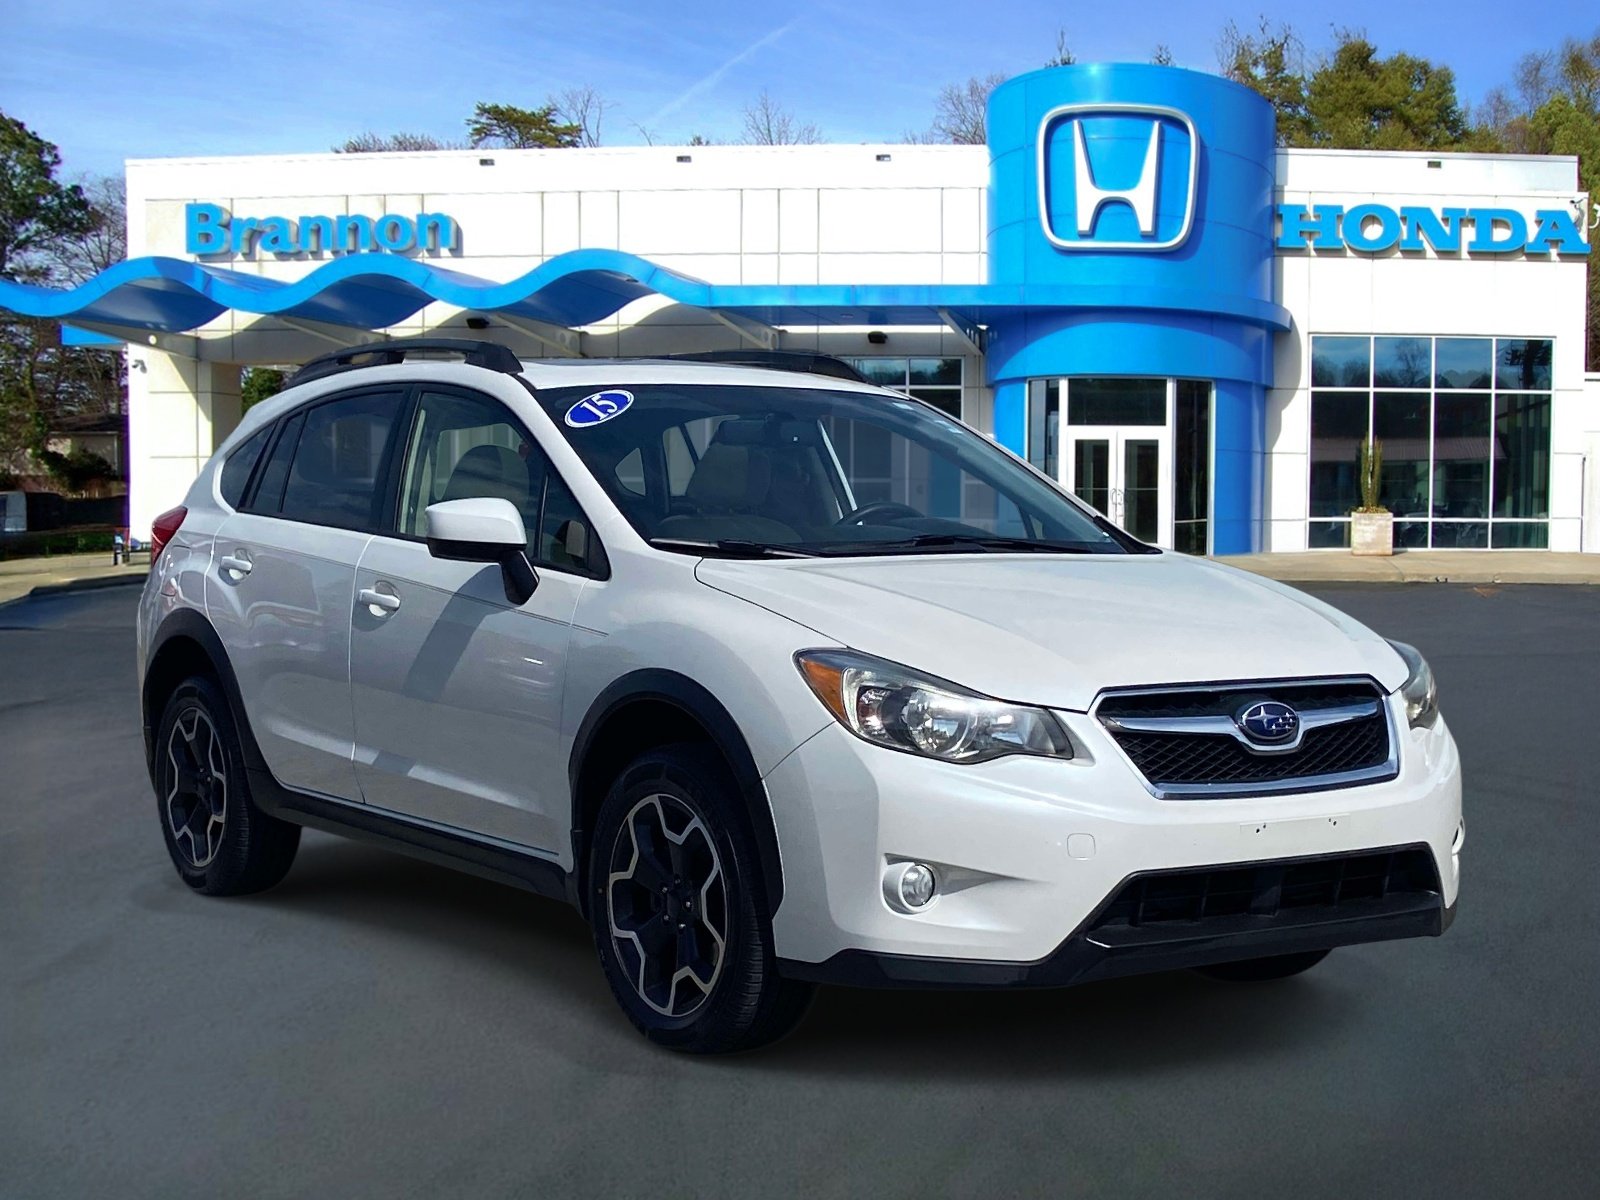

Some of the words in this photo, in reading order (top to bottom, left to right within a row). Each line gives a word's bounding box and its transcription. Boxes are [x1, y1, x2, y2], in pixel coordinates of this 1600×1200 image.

[185, 203, 455, 254] Brannon
[1277, 203, 1591, 254] HONDA
[579, 394, 618, 421] 15
